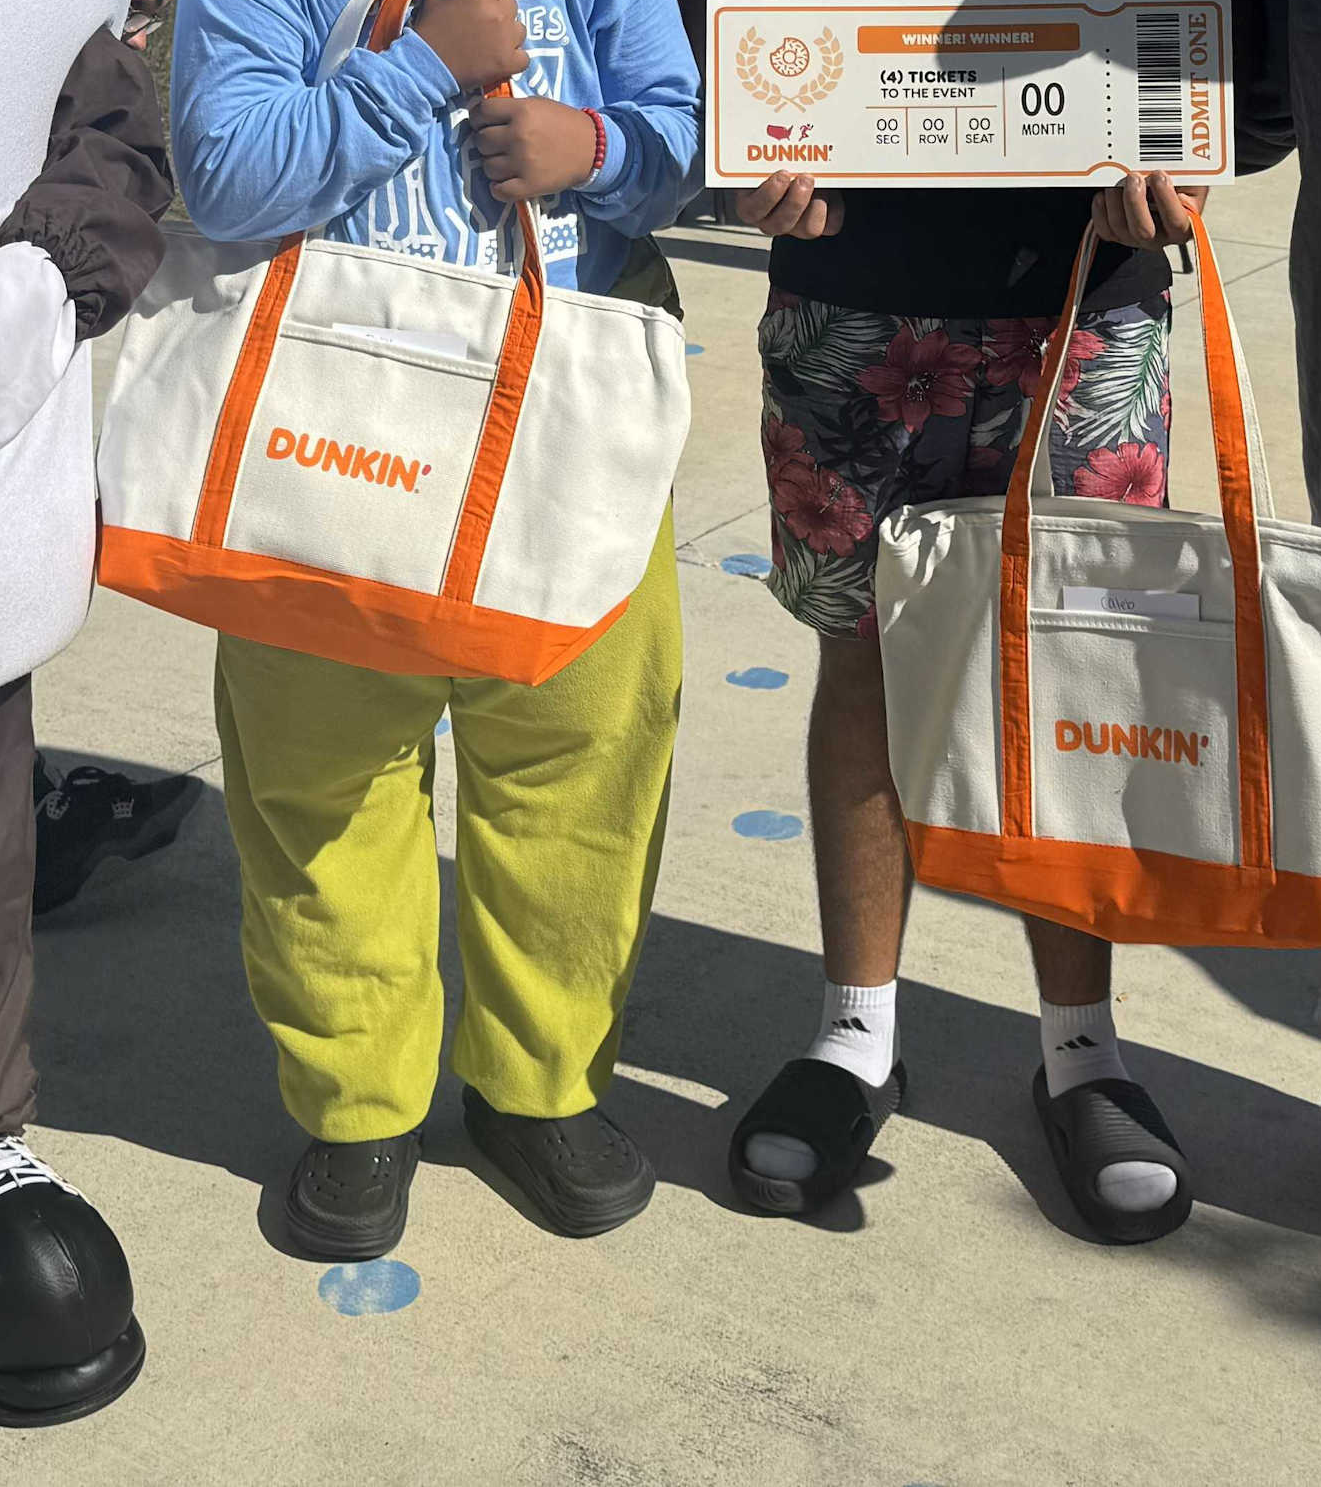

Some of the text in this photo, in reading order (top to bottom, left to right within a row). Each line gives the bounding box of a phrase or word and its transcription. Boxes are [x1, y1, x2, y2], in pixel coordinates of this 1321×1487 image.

[902, 32, 1035, 46] WINNER! WINNER!
[880, 69, 977, 85] (4) TICKETS
[881, 87, 976, 99] TO THE EVENT
[1188, 12, 1211, 161] ADMIT ONE
[1021, 82, 1065, 117] 00
[1021, 123, 1065, 136] MONTH
[876, 134, 900, 145] SEC
[919, 134, 949, 144] ROW
[965, 133, 995, 144] SEAT
[747, 144, 834, 162] DUNKIN'
[265, 426, 432, 492] DUNKIN'
[1054, 719, 1210, 767] DUNKIN'
